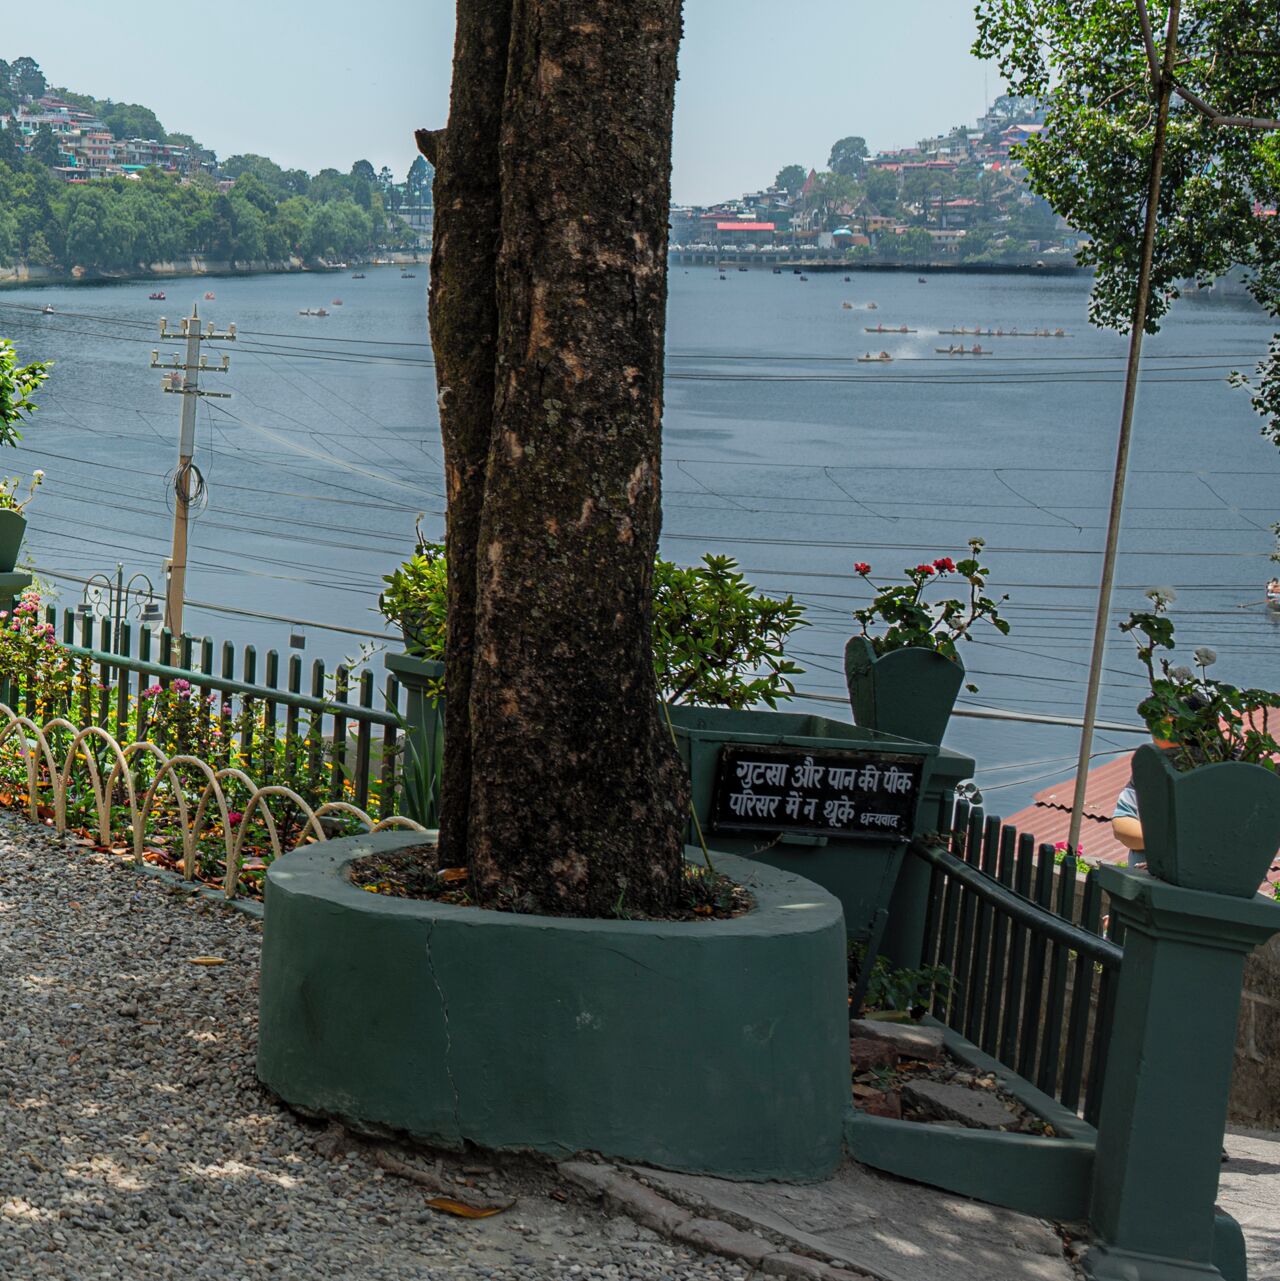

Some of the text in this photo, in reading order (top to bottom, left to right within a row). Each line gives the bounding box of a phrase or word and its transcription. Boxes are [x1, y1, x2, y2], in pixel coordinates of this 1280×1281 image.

[736, 756, 913, 794] गुटखा और पान की पीक
[729, 788, 901, 828] परिसर में न थूके धन्यवाद
